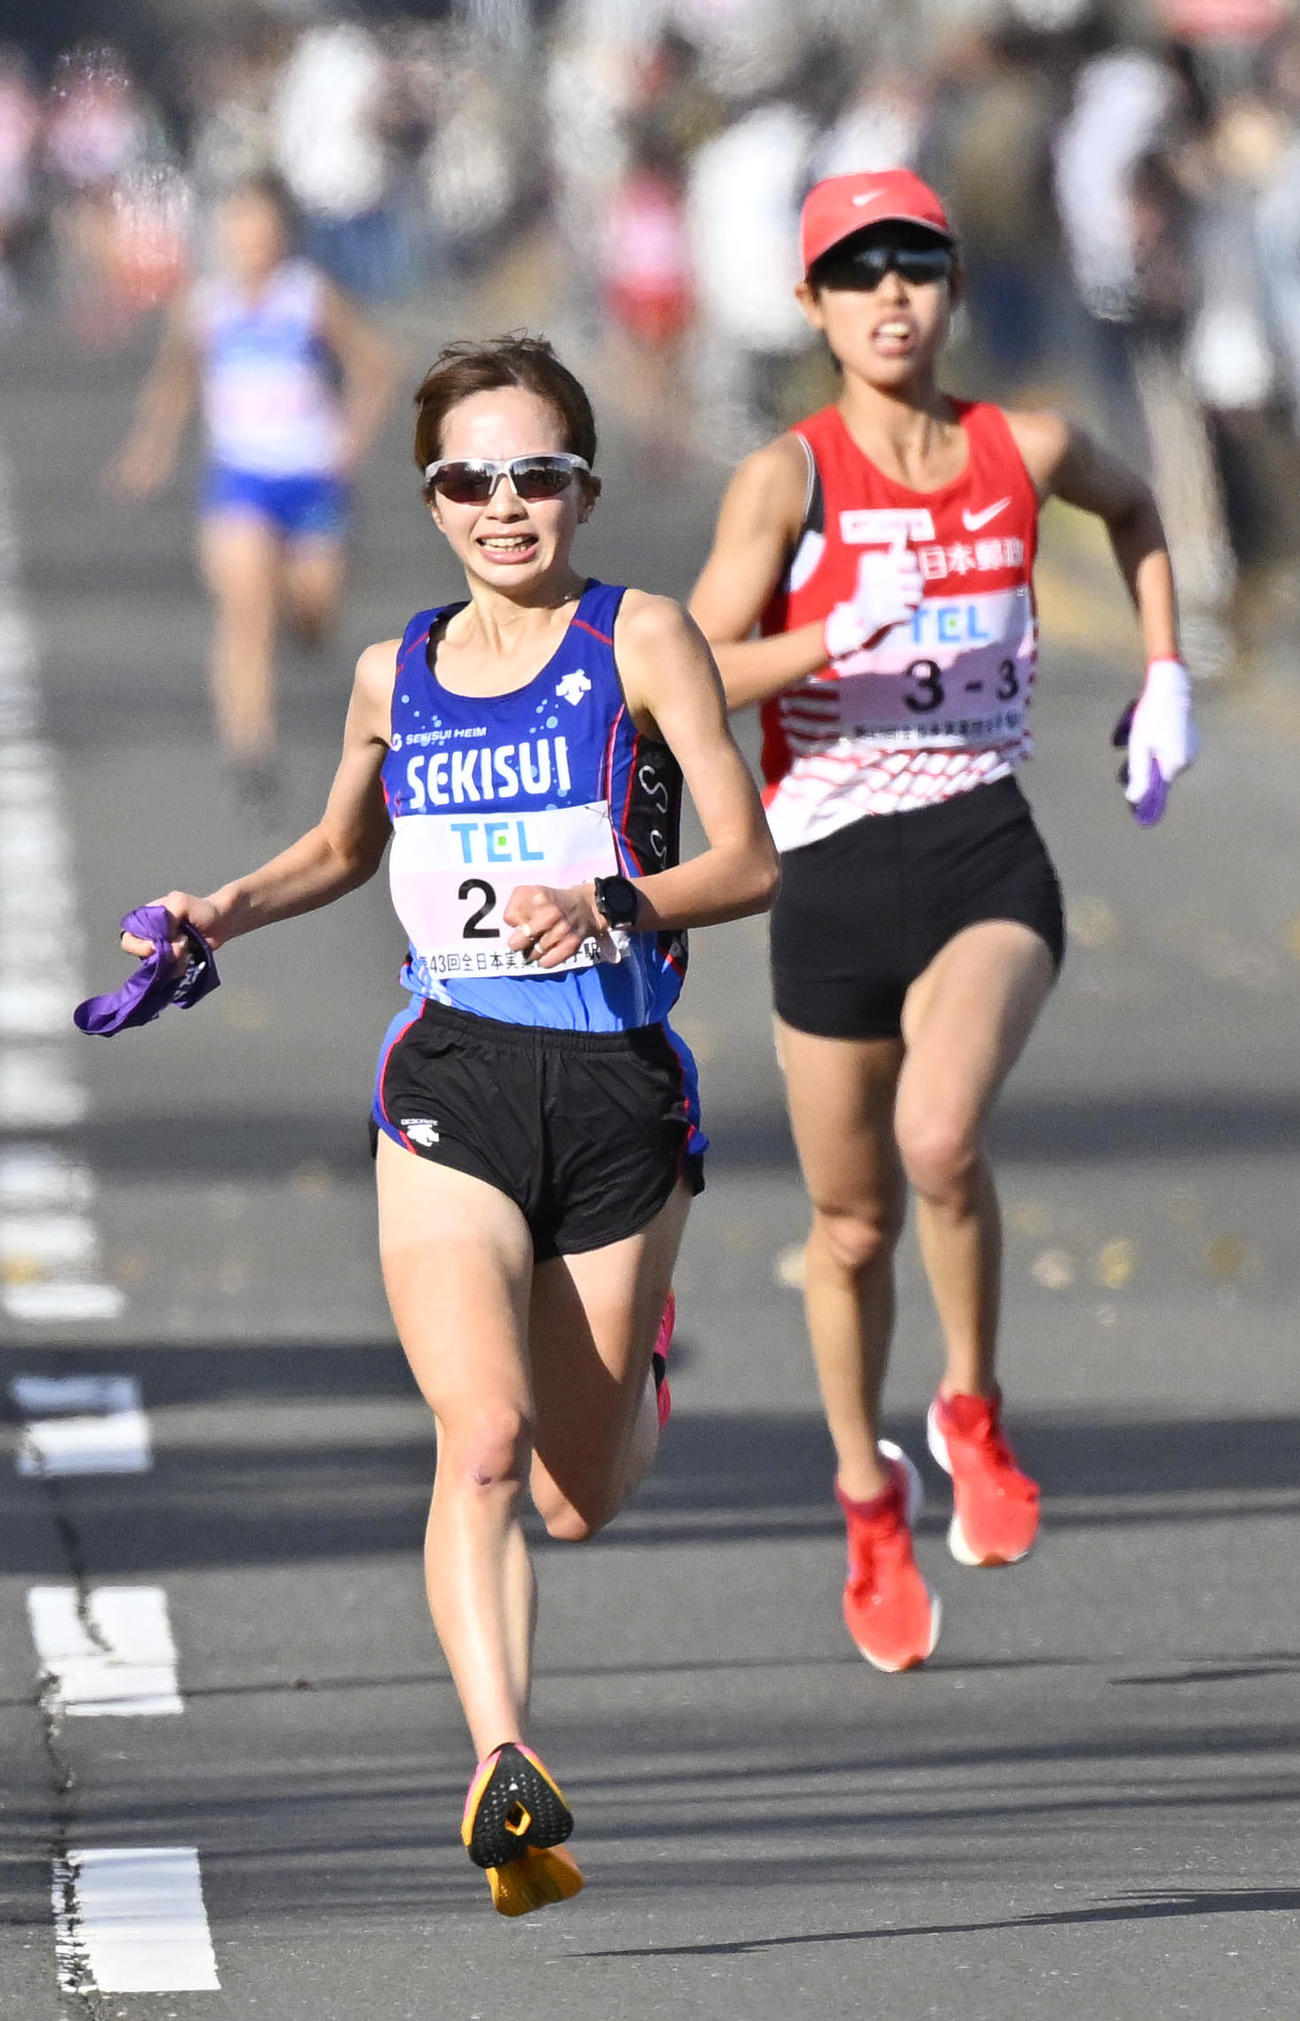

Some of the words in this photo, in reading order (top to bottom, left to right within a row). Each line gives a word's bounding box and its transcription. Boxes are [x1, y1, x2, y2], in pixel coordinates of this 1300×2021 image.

[910, 604, 990, 645] TEL
[405, 729, 453, 746] SEKISUI
[453, 726, 488, 739] HEIM
[406, 735, 572, 809] SEKISUI
[450, 820, 545, 865] TEL
[457, 878, 501, 940] 2
